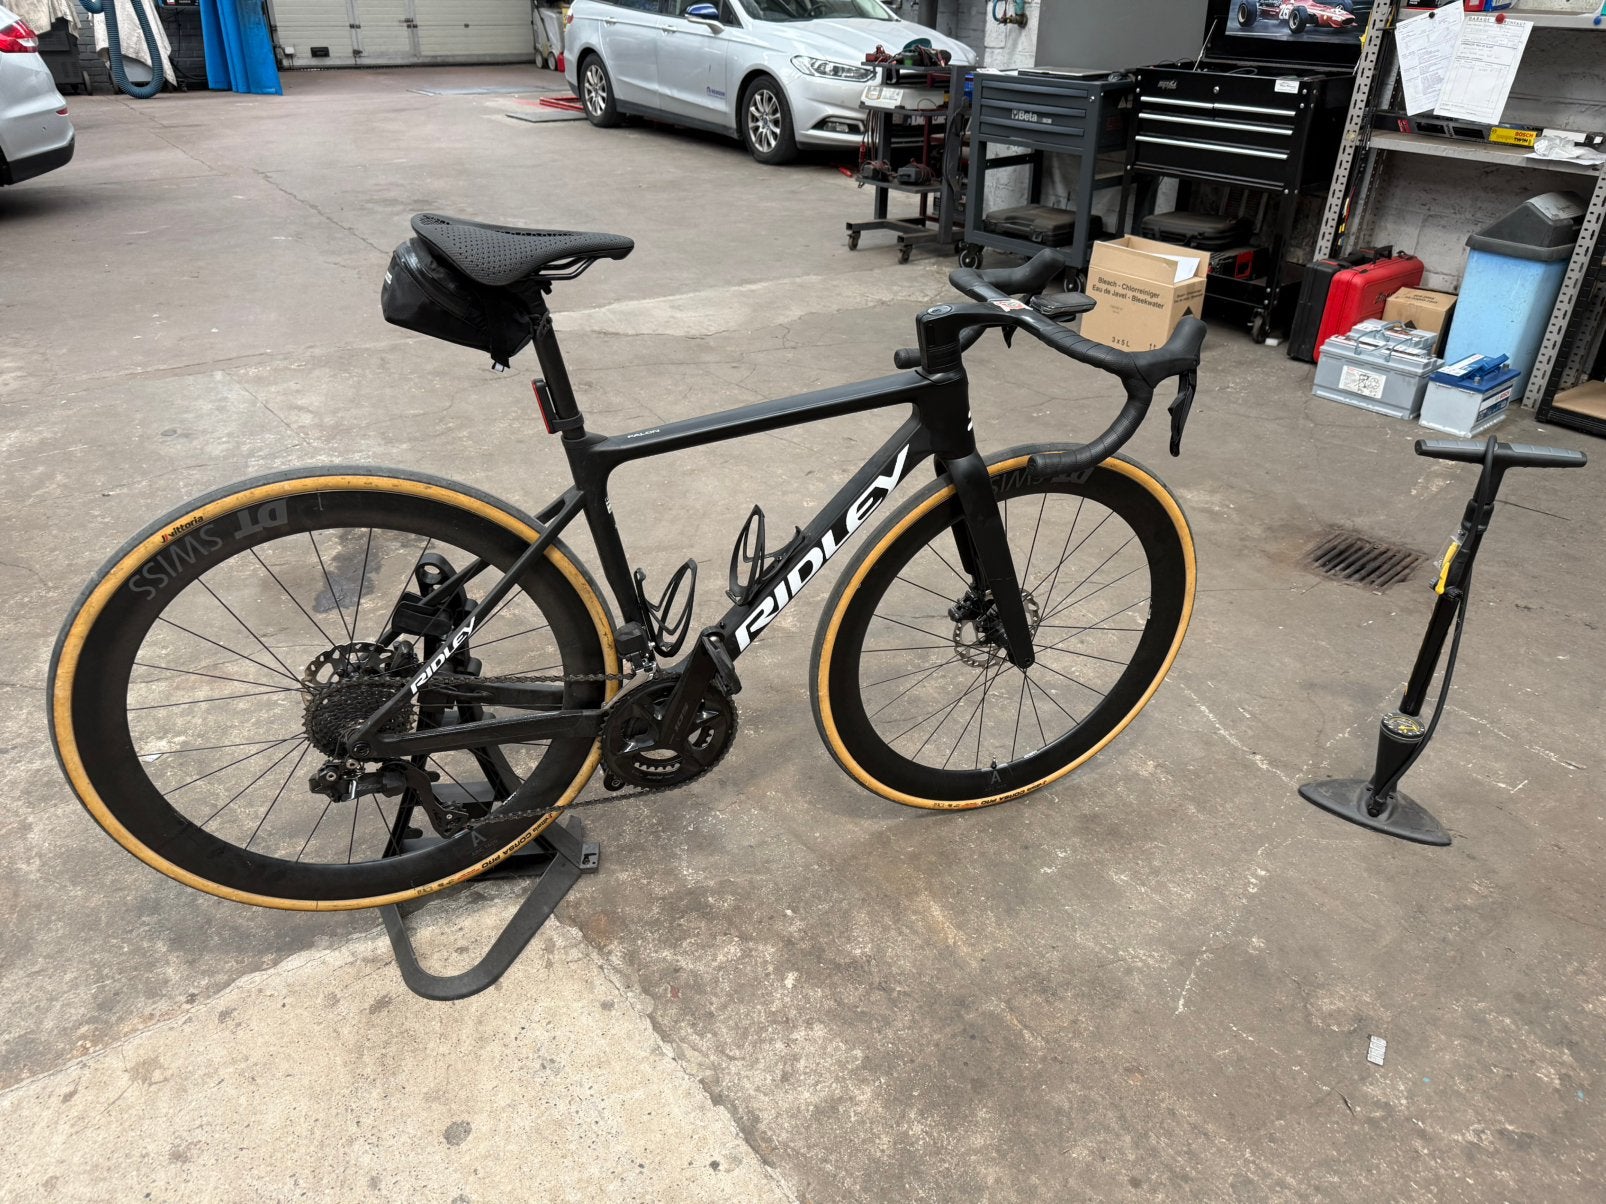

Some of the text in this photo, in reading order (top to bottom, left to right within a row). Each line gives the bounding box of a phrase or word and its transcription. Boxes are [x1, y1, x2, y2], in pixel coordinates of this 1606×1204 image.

[1018, 111, 1037, 121] Beta
[1092, 284, 1102, 293] Eau
[1103, 288, 1111, 296] de
[1112, 291, 1127, 300] Javel
[1131, 295, 1164, 309] Bleekwater
[1098, 276, 1118, 288] Bleach
[1121, 283, 1160, 299] Chlorreiniger
[168, 515, 204, 537] vittoria
[128, 499, 288, 600] DT SWISS
[734, 443, 909, 652] RIDLEY
[410, 616, 476, 695] RIDLEY
[503, 832, 532, 855] CORSA
[481, 854, 501, 869] PRO
